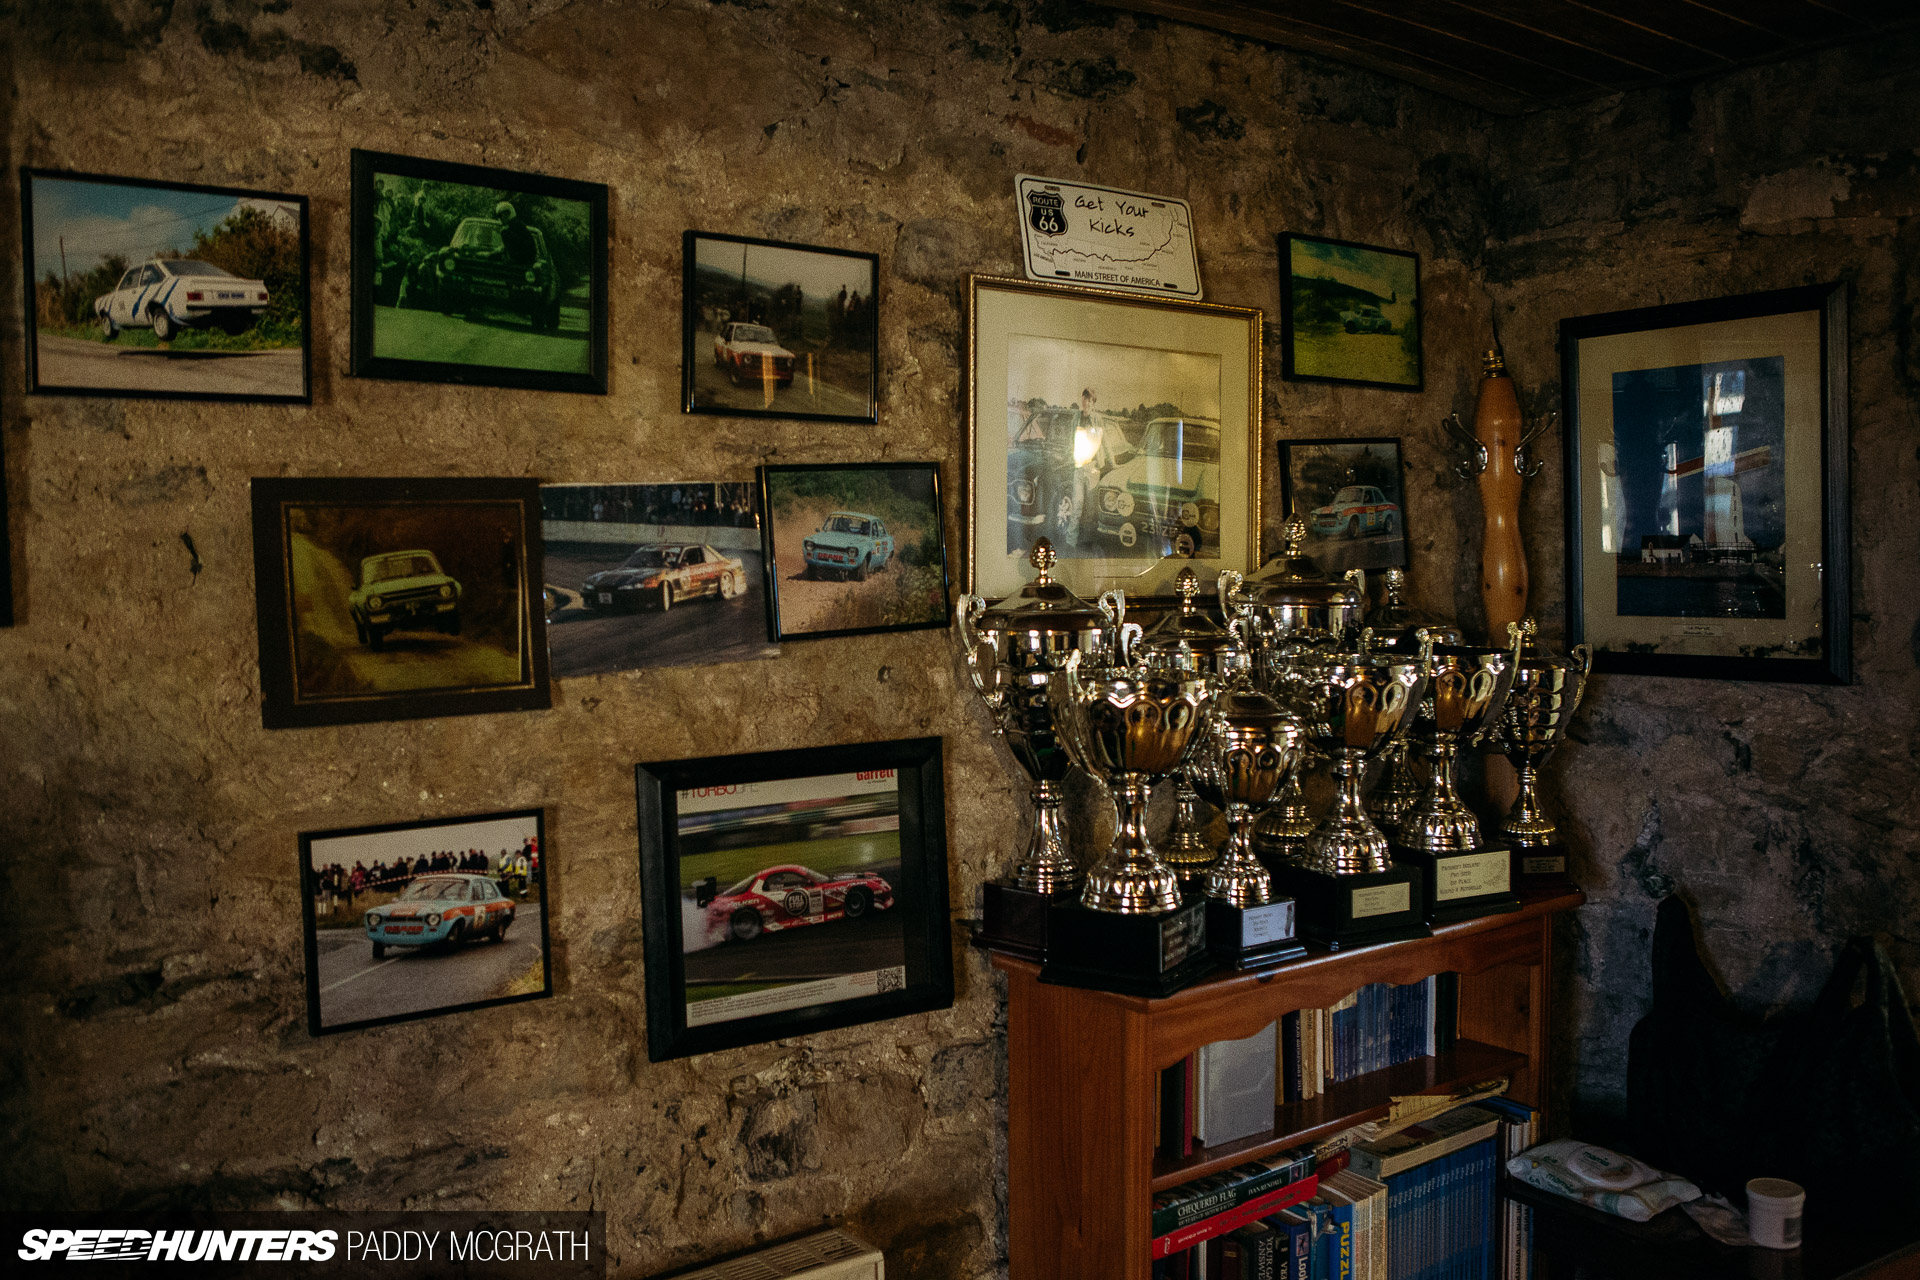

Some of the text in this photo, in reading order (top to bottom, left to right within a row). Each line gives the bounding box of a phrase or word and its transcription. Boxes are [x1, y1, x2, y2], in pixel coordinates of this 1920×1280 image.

[1032, 197, 1060, 207] ROUTE
[1074, 195, 1149, 218] Get Your
[1040, 208, 1054, 217] US
[1038, 217, 1059, 232] 66
[1089, 217, 1135, 237] Kicks
[1074, 270, 1161, 287] MAIN STREET OF AMERICA
[1177, 1195, 1219, 1217] CHEQUERED
[1219, 1188, 1237, 1203] FLAG
[1265, 1236, 1275, 1266] YOUR
